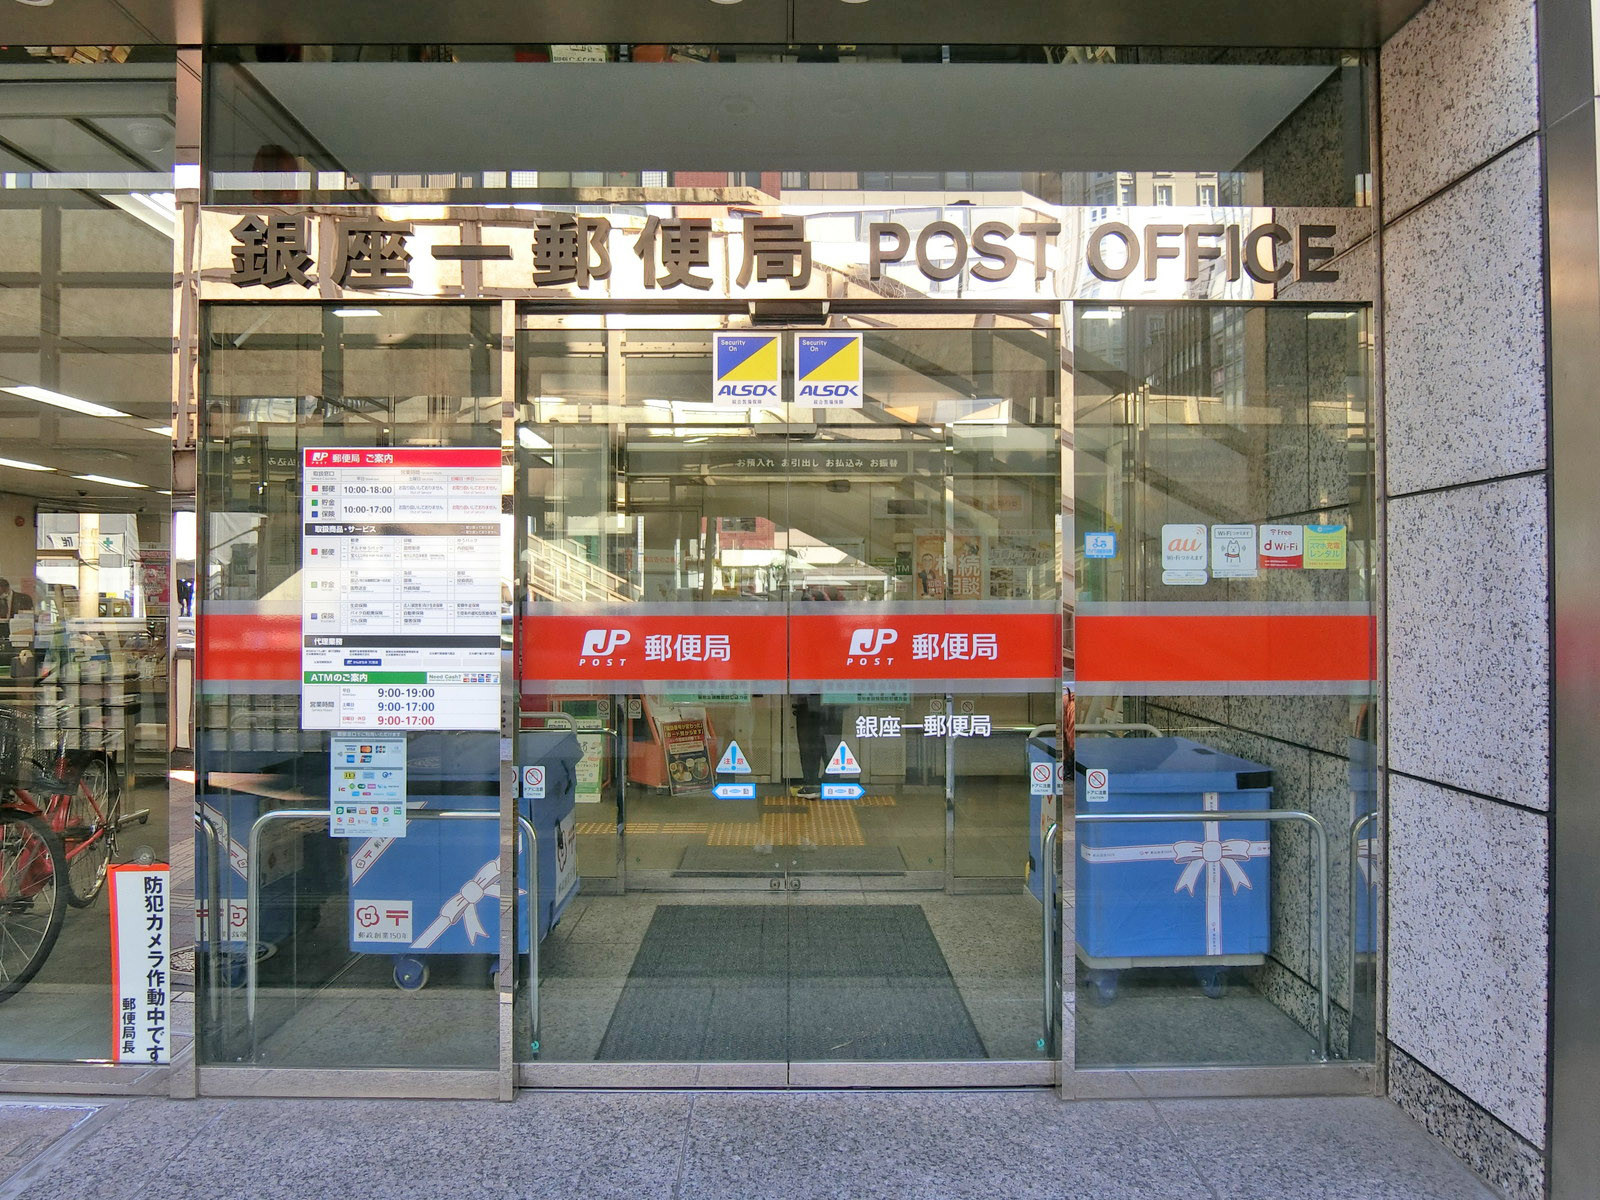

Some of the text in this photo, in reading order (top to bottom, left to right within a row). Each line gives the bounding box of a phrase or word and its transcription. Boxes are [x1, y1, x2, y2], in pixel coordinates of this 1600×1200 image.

[229, 214, 1340, 291] 銀座一郵便局 POST OFFICE
[718, 385, 777, 396] ALSOK
[800, 385, 858, 396] ALSOK
[332, 453, 394, 464] 郵便局 ご案内
[781, 458, 820, 468] お引出し
[825, 458, 864, 468] お払込み
[870, 458, 898, 468] お振替
[1168, 538, 1202, 552] au
[1264, 540, 1272, 551] d
[644, 634, 731, 662] 郵便局
[912, 633, 998, 661] 郵便局
[578, 658, 626, 666] POST
[846, 657, 894, 666] POST
[310, 673, 368, 682] ATMのご案内
[378, 688, 435, 698] 9:00-19:00
[378, 702, 435, 712] 9:00-17:00
[378, 716, 435, 726] 9:00-17:00
[855, 714, 991, 738] 銀座一郵便局
[144, 876, 165, 1063] 防犯カメラ作動中です
[122, 998, 136, 1054] 郵便局長
